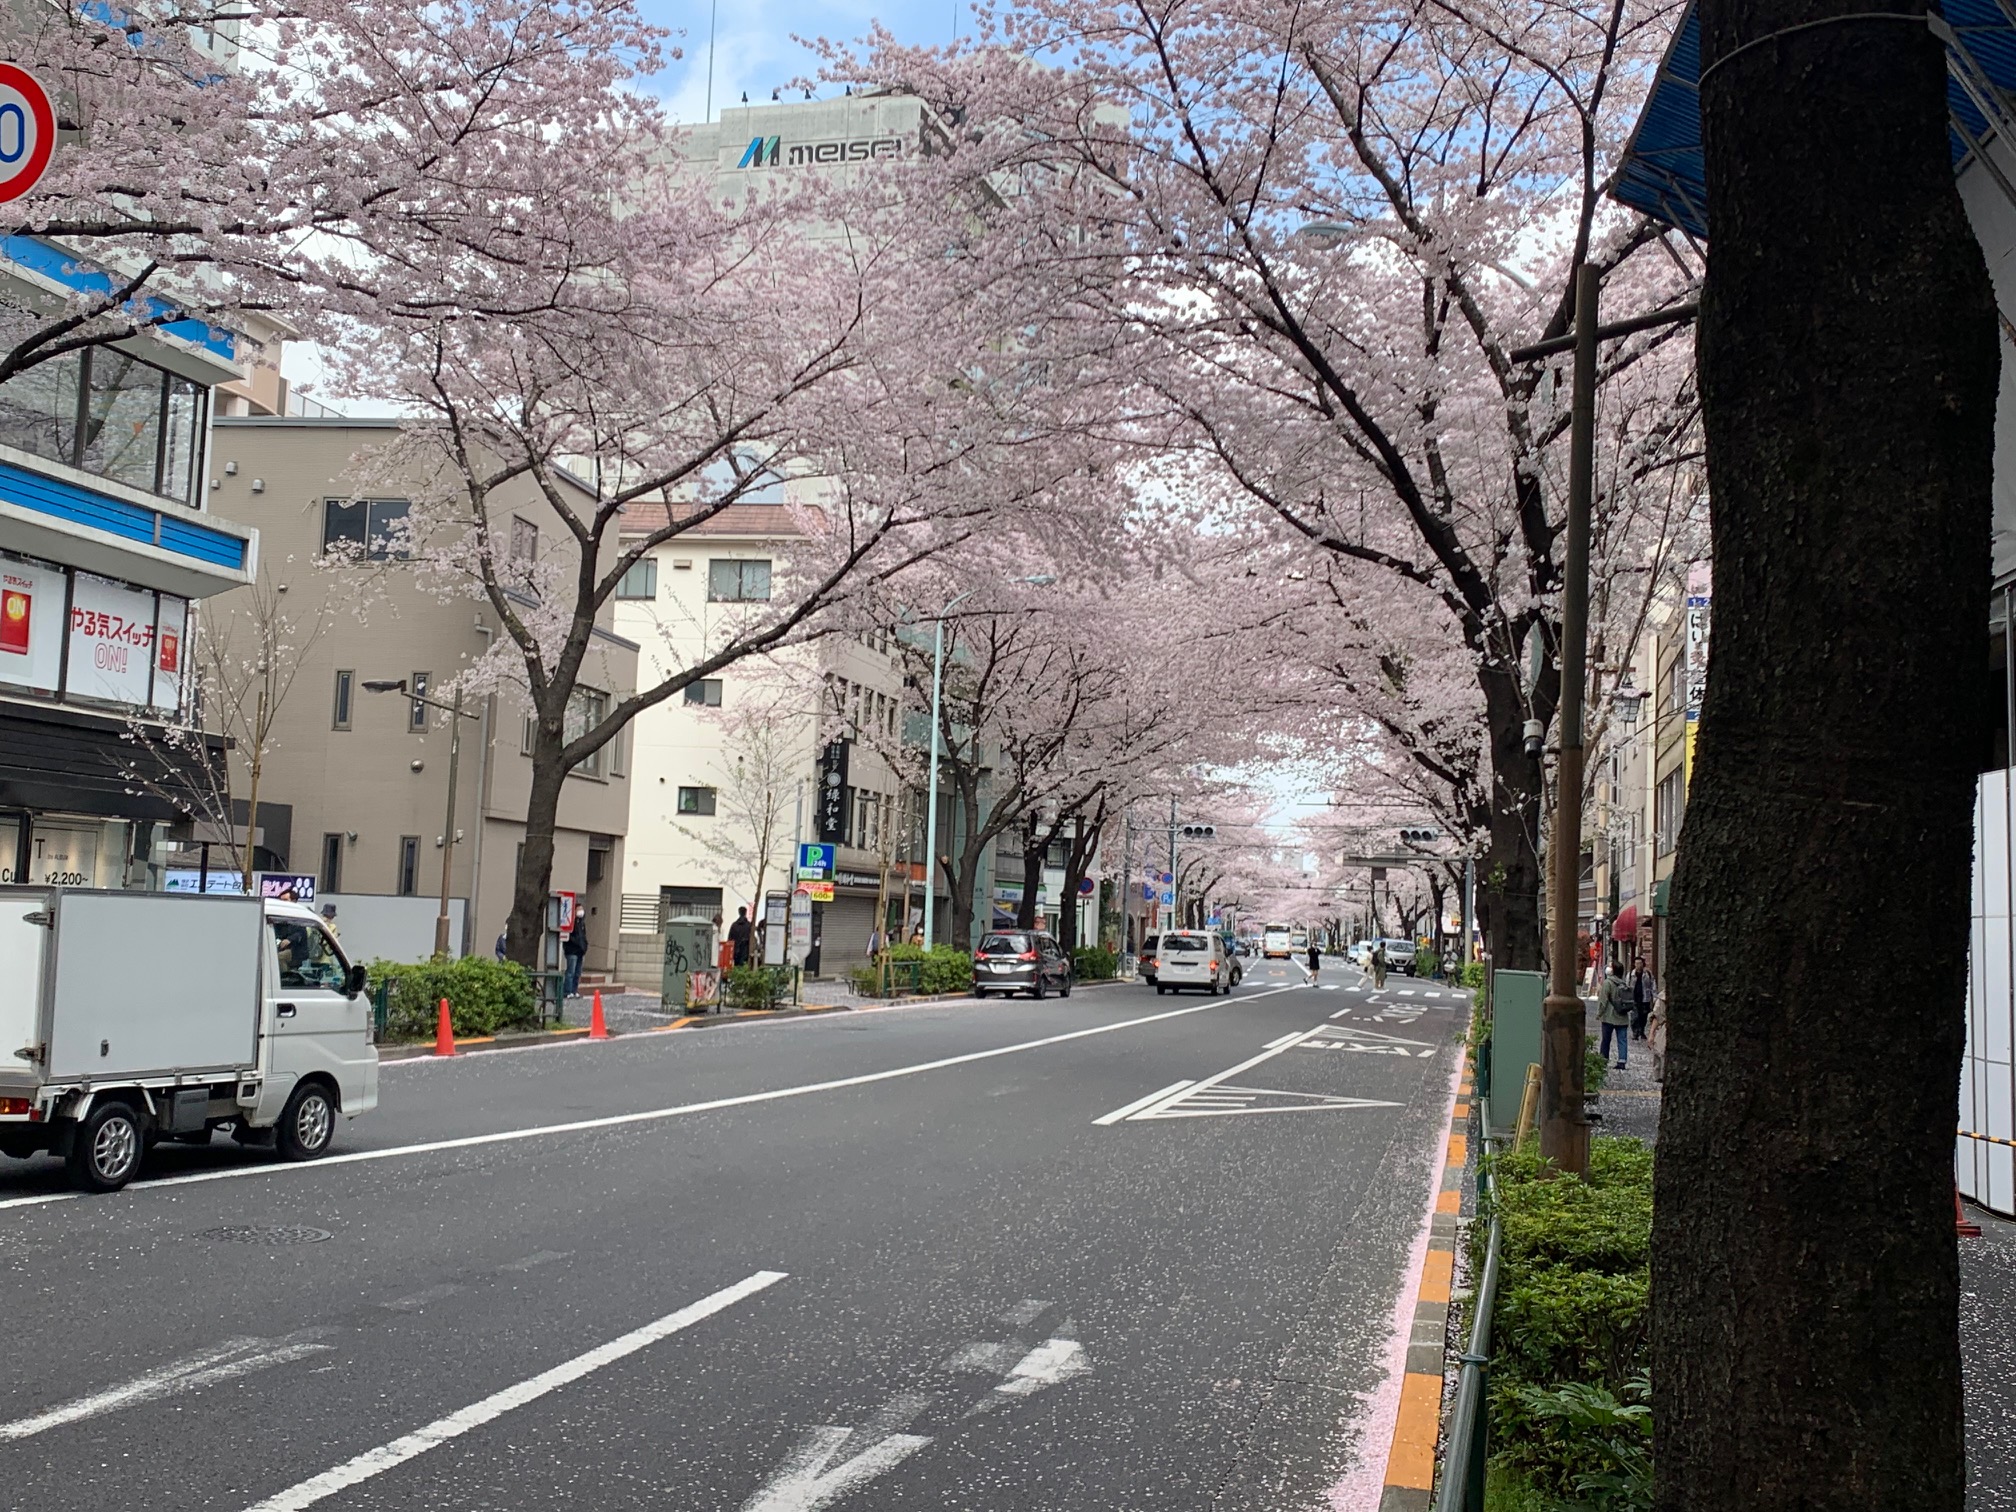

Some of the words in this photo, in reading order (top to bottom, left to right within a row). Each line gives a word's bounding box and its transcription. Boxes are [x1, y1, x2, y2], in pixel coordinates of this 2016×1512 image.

[6, 597, 26, 617] ON
[70, 606, 155, 648] やる気スイッチ
[95, 642, 129, 674] ON!
[34, 838, 46, 859] T
[806, 845, 824, 868] P
